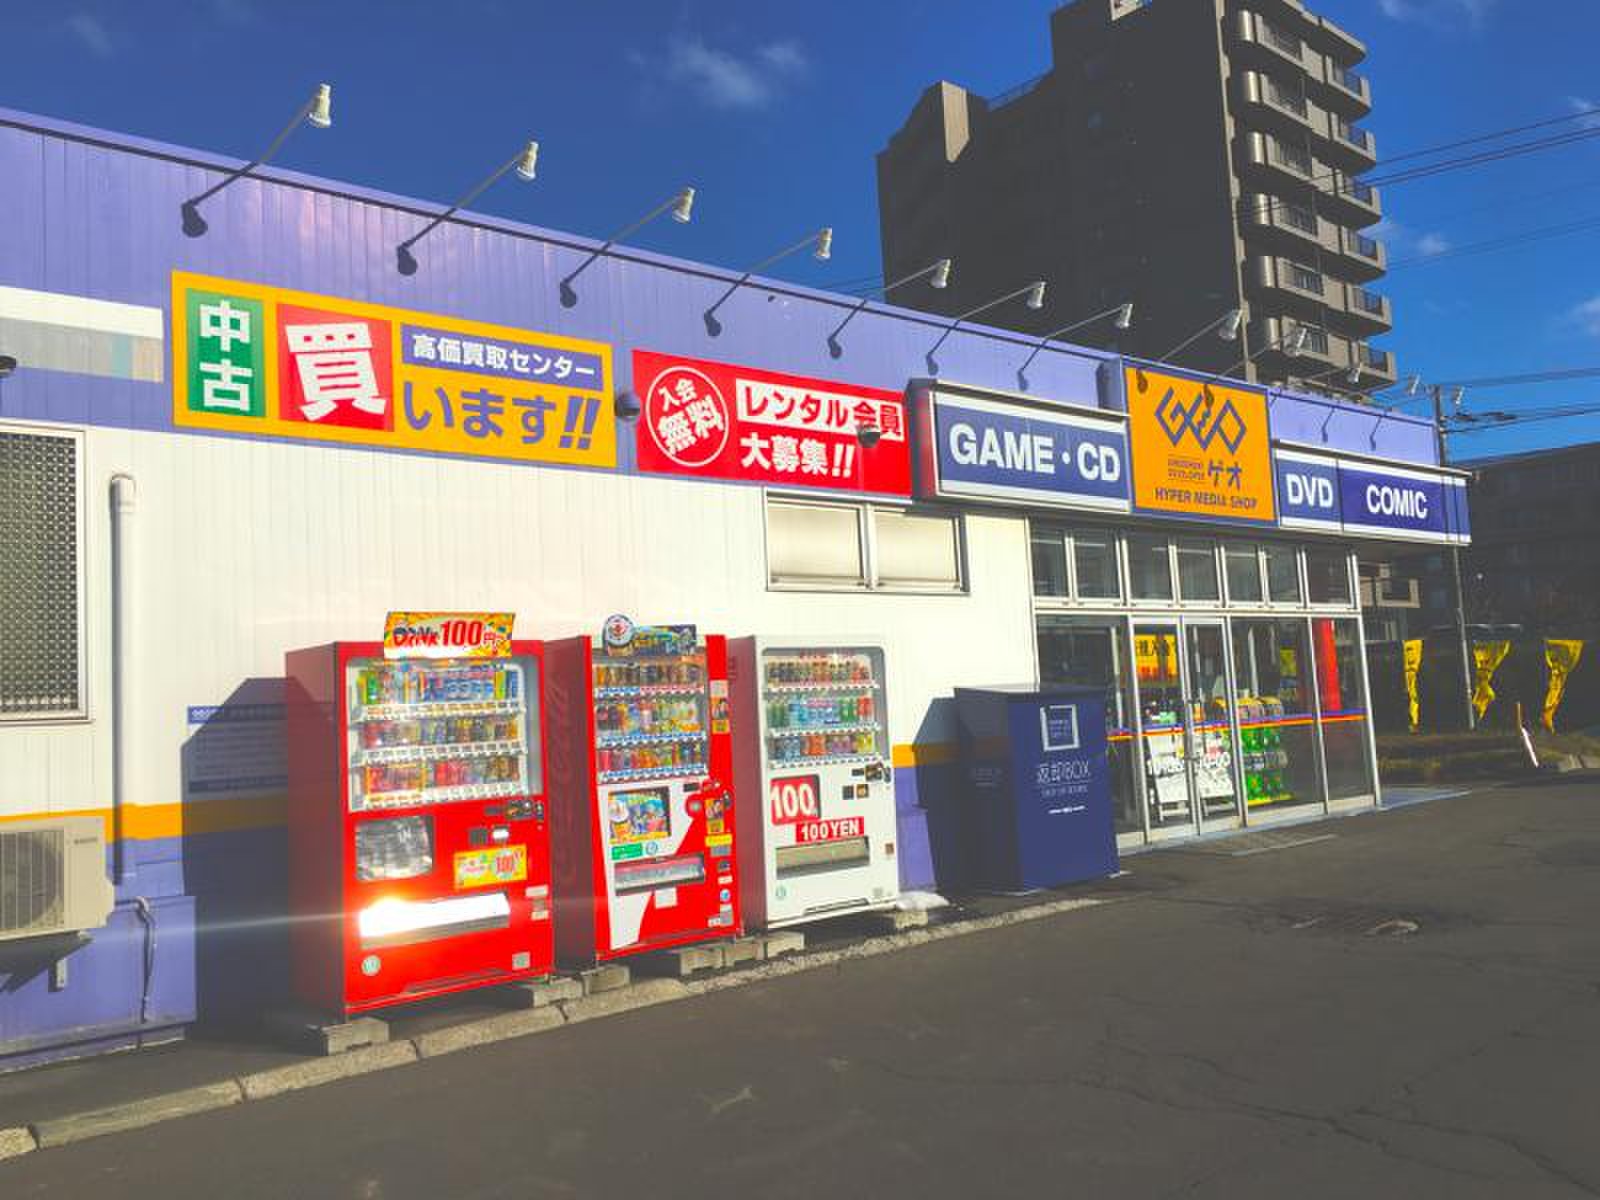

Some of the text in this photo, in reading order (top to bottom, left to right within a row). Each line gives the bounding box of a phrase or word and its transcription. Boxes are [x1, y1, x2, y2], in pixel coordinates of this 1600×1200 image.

[200, 300, 252, 411] 中古
[412, 333, 595, 378] 高価買取センター
[658, 378, 697, 412] 入会
[744, 386, 902, 437] レンタル会員
[657, 395, 724, 455] 無料
[1208, 459, 1242, 490] ゲオ
[1285, 473, 1333, 508] DVD
[1155, 487, 1257, 508] HYPER MEDIA SHOP
[1366, 484, 1428, 519] COMIC
[771, 783, 815, 818] 100
